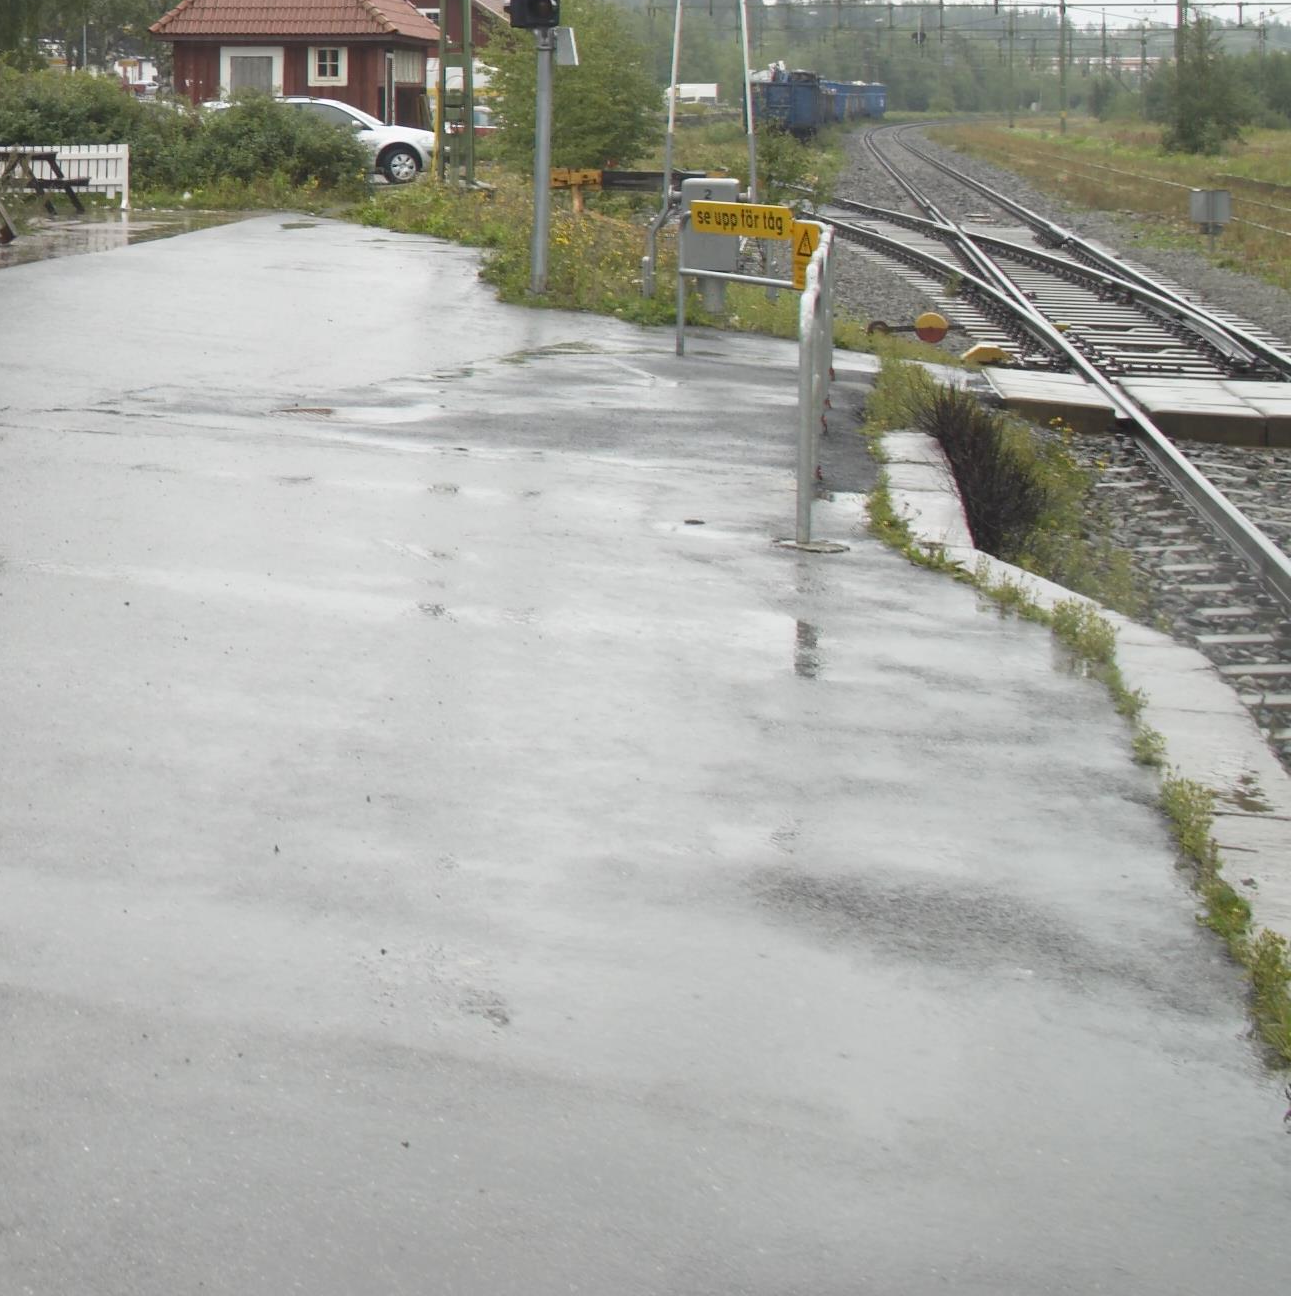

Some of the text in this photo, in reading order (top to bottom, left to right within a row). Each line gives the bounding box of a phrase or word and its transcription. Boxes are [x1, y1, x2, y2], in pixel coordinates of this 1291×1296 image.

[704, 188, 713, 200] 2
[697, 209, 783, 236] se upp för tåg
